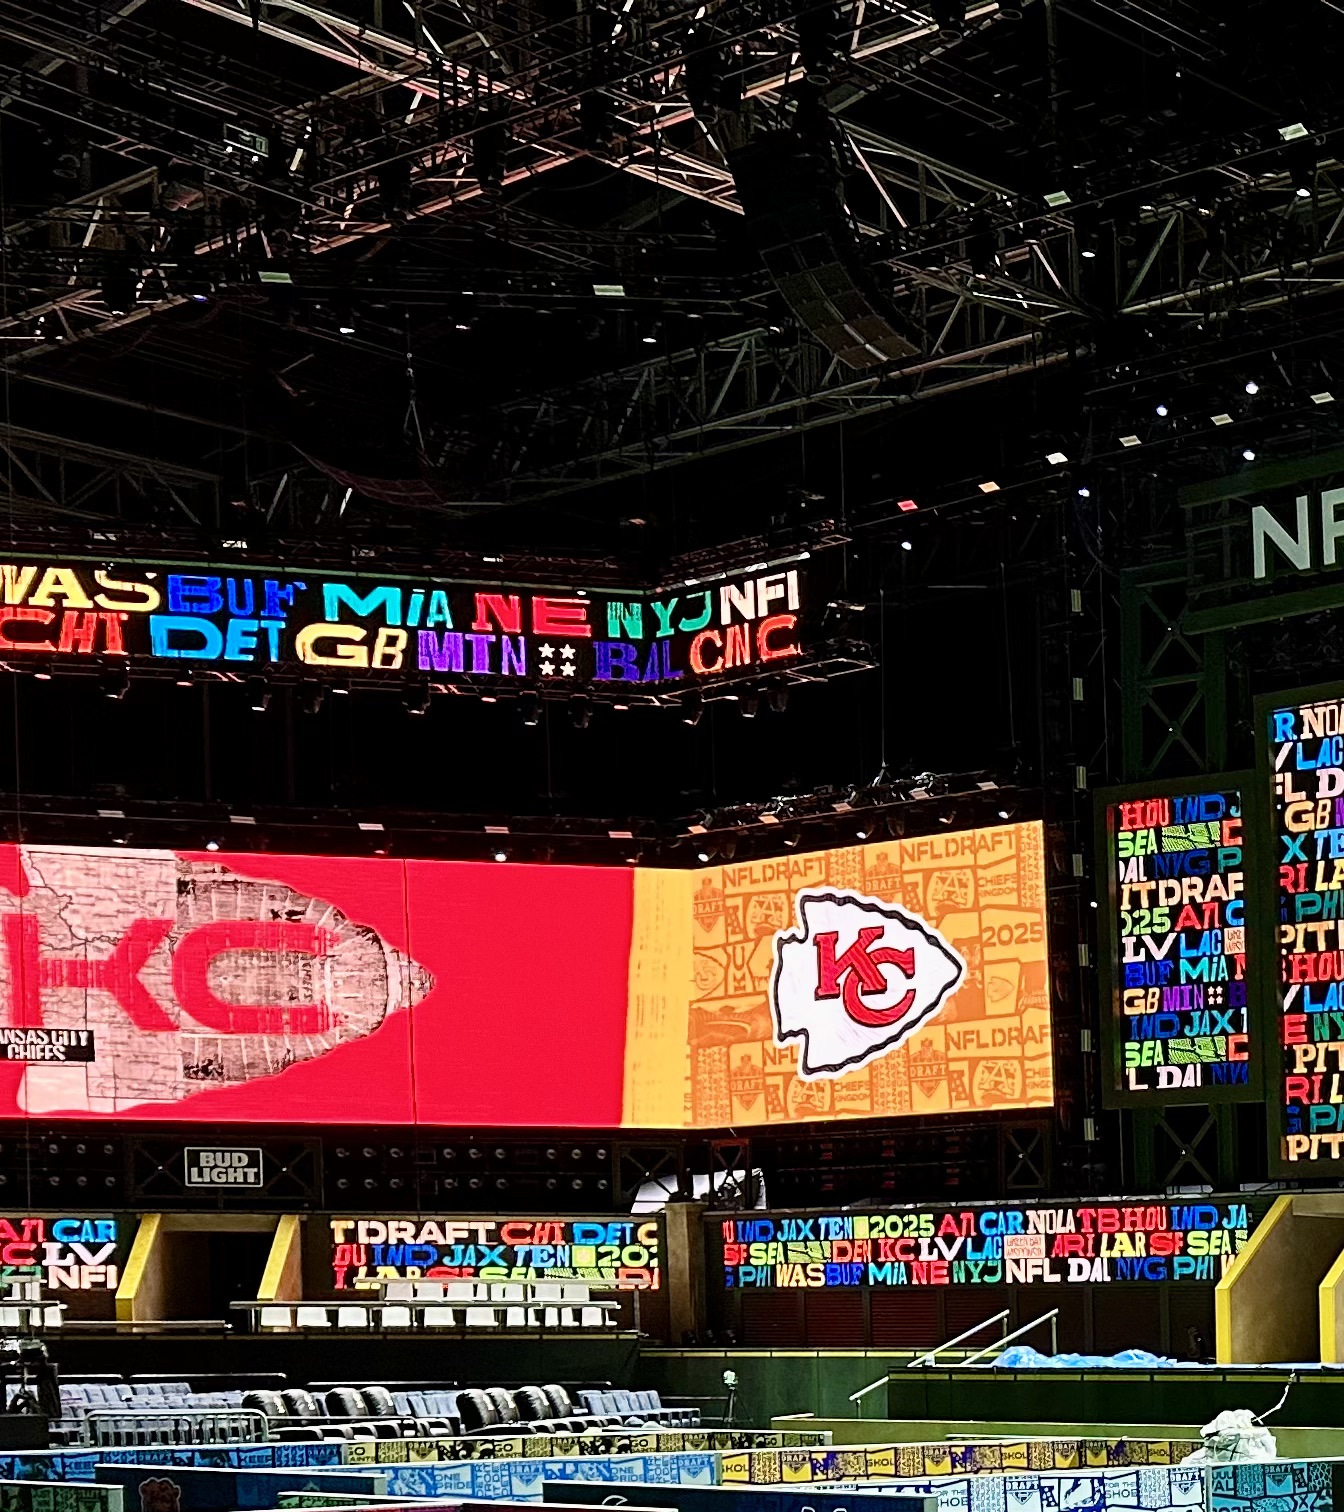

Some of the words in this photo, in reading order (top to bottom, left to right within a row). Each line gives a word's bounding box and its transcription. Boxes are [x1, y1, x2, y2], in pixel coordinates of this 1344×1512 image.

[0, 564, 161, 612] WAS
[167, 574, 307, 617] BUF
[323, 582, 454, 630] MIA
[472, 592, 591, 637] NE
[607, 591, 711, 639] NYJ
[0, 606, 128, 655] CHI
[150, 615, 285, 661] DET
[295, 623, 407, 669] GB
[593, 640, 683, 682] BAL
[690, 623, 750, 674] CIN
[1297, 735, 1344, 770] LAC
[1119, 799, 1170, 830] HOU
[1173, 793, 1226, 823] IND
[1284, 800, 1332, 832] GB
[902, 841, 942, 863] NFL
[945, 830, 1015, 858] DRAFT
[723, 866, 760, 888] NFL
[763, 857, 826, 881] DRAFT
[866, 878, 901, 891] DRAFT
[982, 922, 1043, 947] 2025
[1122, 932, 1177, 964] LV
[1180, 928, 1222, 958] LAC
[814, 925, 915, 1028] KC
[1180, 955, 1229, 983] MIA
[1123, 988, 1159, 1015] GB
[1130, 1013, 1180, 1041] IND
[1184, 1009, 1237, 1037] JAX
[8, 1043, 66, 1061] CHIEFS
[947, 1030, 989, 1051] NFL
[910, 1064, 946, 1077] DRAFT
[200, 1152, 248, 1167] BUD
[190, 1168, 257, 1183] LIGHT
[52, 1219, 118, 1243] CAR
[358, 1221, 496, 1245] DRAFT
[573, 1222, 634, 1245] DET
[737, 1221, 774, 1242] IND
[777, 1219, 815, 1241] JAX
[869, 1214, 934, 1239] 2025
[980, 1211, 1025, 1236] CAR
[1026, 1209, 1075, 1235] NOLA
[1122, 1206, 1167, 1231] HOU
[42, 1242, 117, 1266] LV
[442, 1245, 505, 1267] JAX
[878, 1239, 915, 1262] KC
[919, 1236, 964, 1261] LV
[1187, 1230, 1231, 1255] SEA
[912, 1261, 949, 1285] NE
[1005, 1258, 1061, 1283] NFL
[1006, 1481, 1039, 1490] DRAFT
